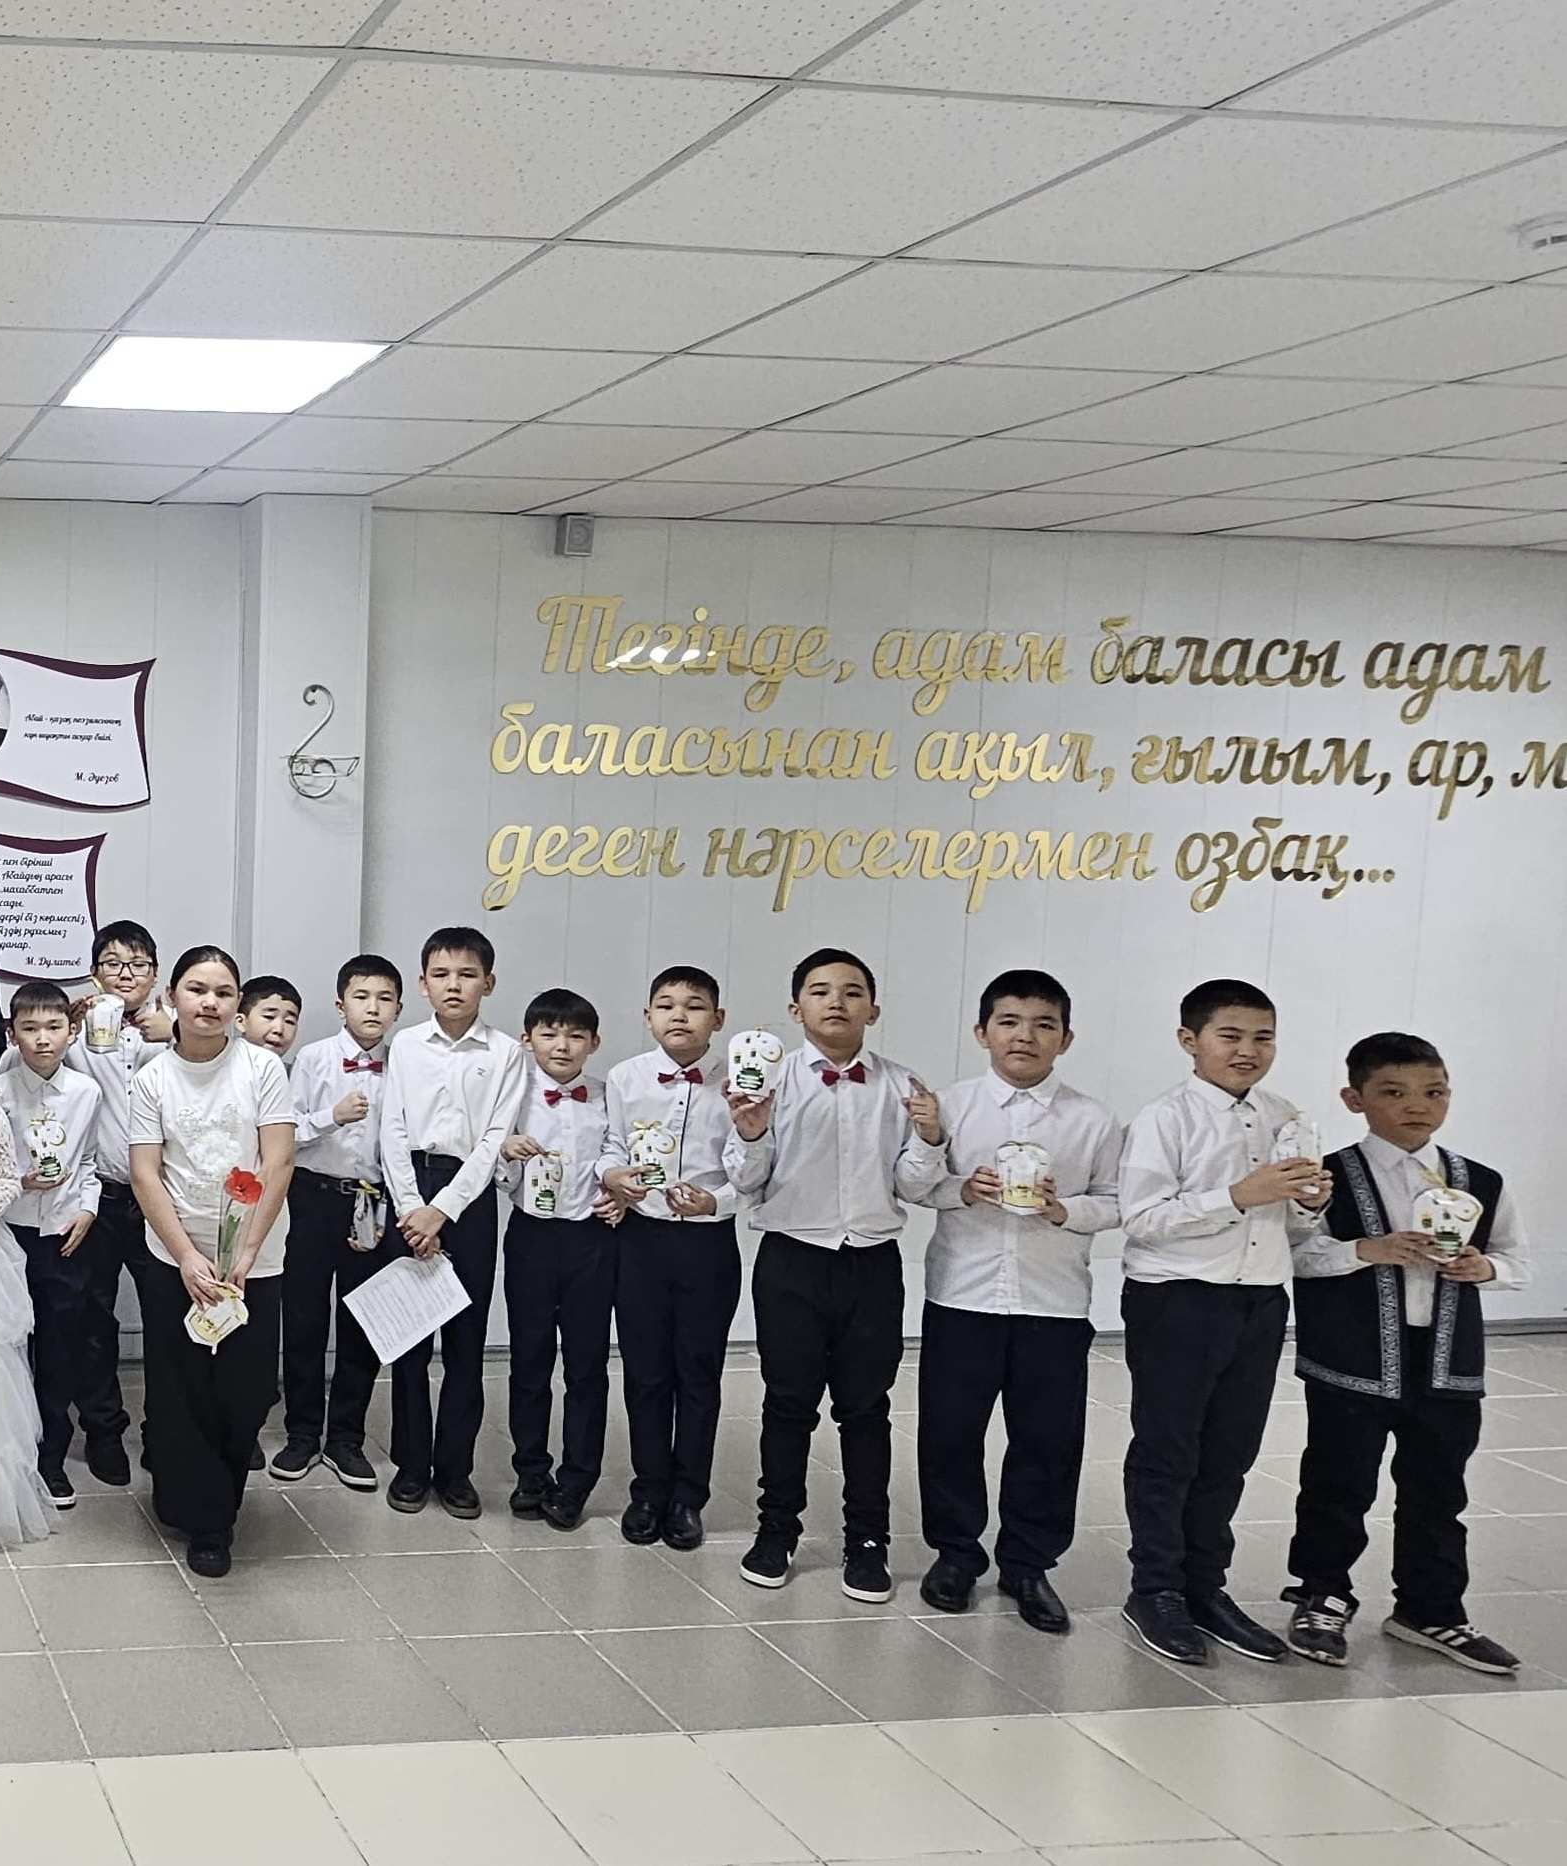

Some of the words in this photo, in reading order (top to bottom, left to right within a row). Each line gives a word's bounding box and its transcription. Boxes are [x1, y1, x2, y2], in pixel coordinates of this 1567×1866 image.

[537, 594, 857, 712] Тегінде,
[873, 625, 1071, 716] адам
[1091, 614, 1346, 686] баласы
[1364, 638, 1552, 725] адам
[25, 714, 43, 722] Абай
[49, 716, 71, 726] қазақ
[490, 702, 897, 780] баласынан
[915, 728, 1115, 800] ақыл,
[1130, 732, 1392, 796] ғылым,
[1407, 737, 1494, 821] ар,
[75, 772, 85, 782] М.
[88, 772, 120, 784] Әуезов
[20, 857, 53, 868] бірінші
[482, 824, 685, 911] деген
[702, 827, 1157, 914] нәрселермен
[1174, 817, 1396, 912] озбақ...
[2, 870, 43, 882] Абайдың
[45, 873, 74, 882] арасы
[1, 884, 64, 895] махаббатпен
[24, 912, 38, 923] біз
[24, 928, 67, 938] рухымыз
[26, 957, 36, 966] М.
[38, 957, 82, 968] Дулатов
